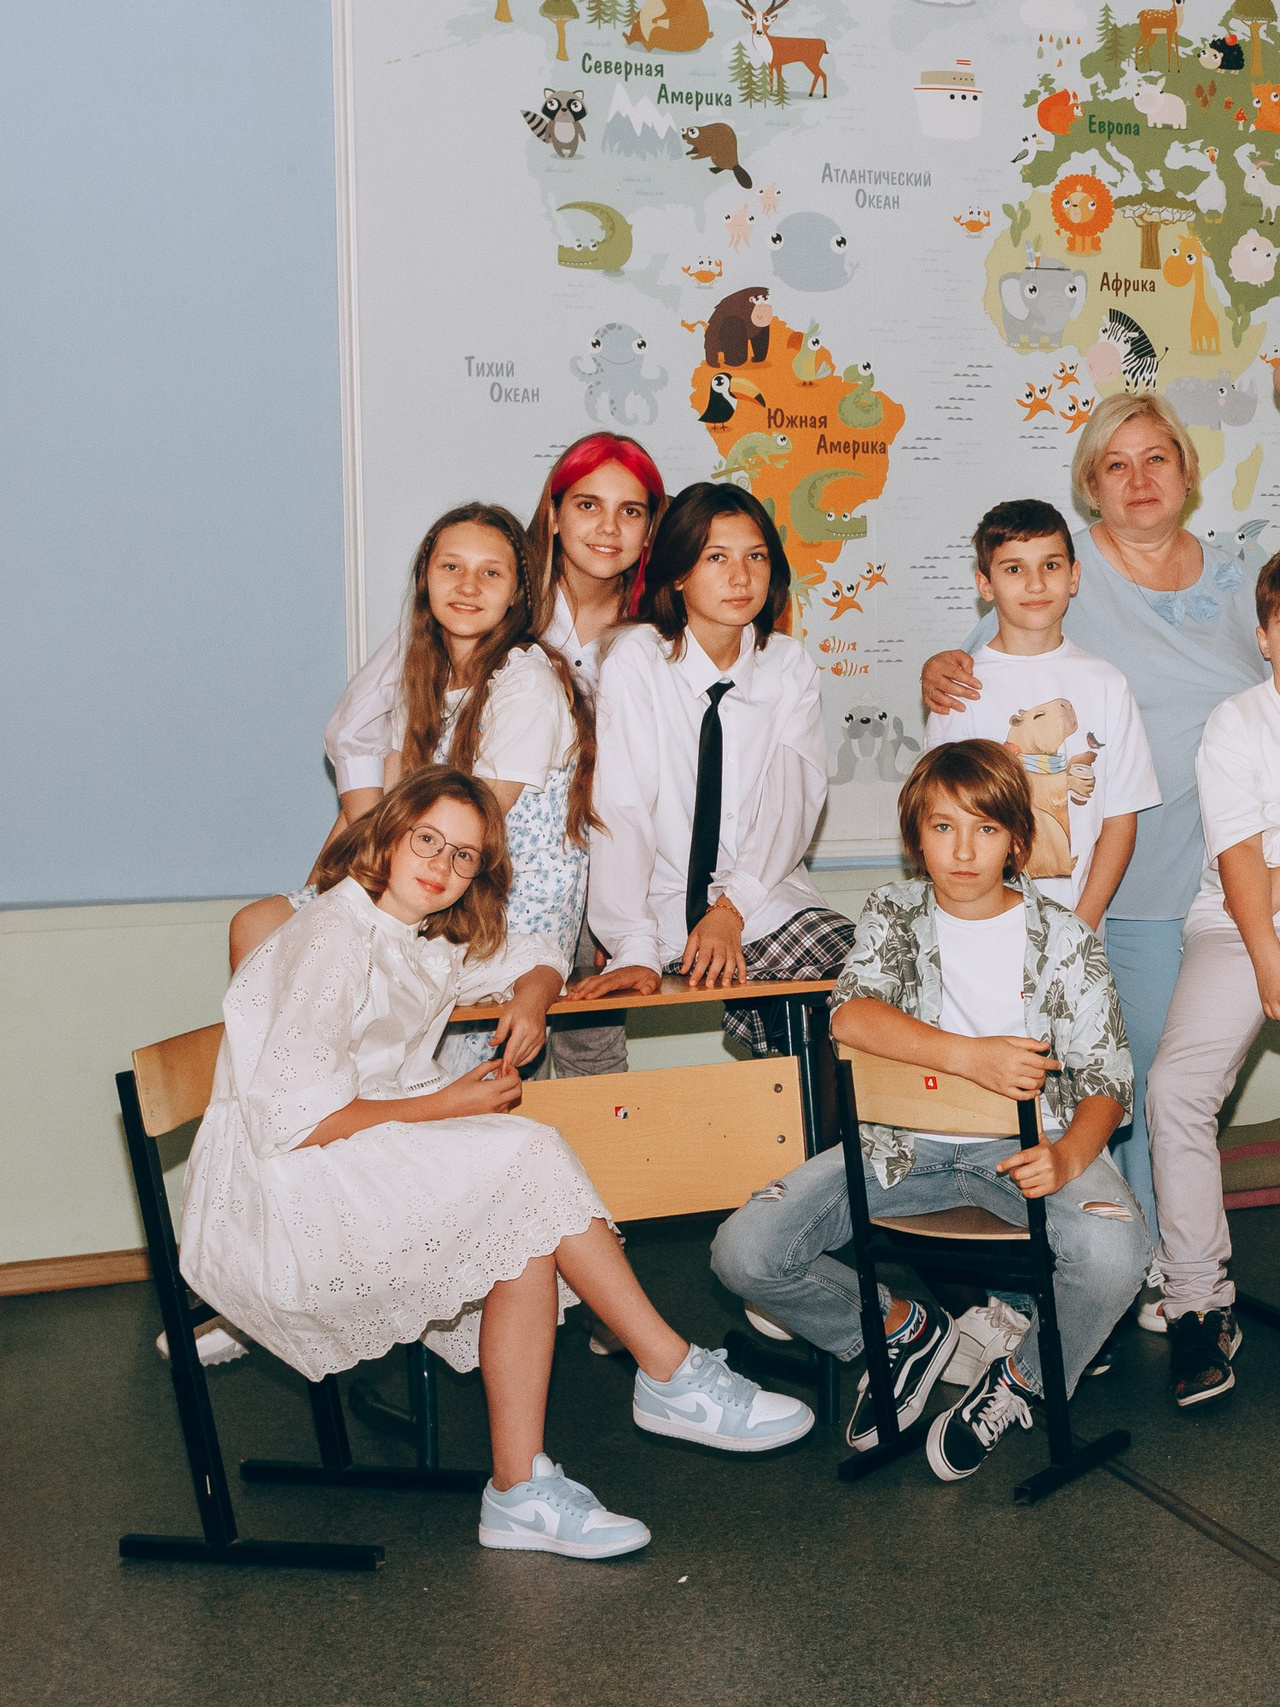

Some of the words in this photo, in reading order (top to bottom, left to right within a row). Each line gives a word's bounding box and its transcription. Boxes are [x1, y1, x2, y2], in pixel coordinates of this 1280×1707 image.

[581, 52, 664, 82] Северная
[657, 83, 732, 111] Америка
[1088, 114, 1140, 140] Европа
[1100, 272, 1156, 297] Африка
[767, 408, 828, 429] Южная
[816, 434, 887, 460] Америка
